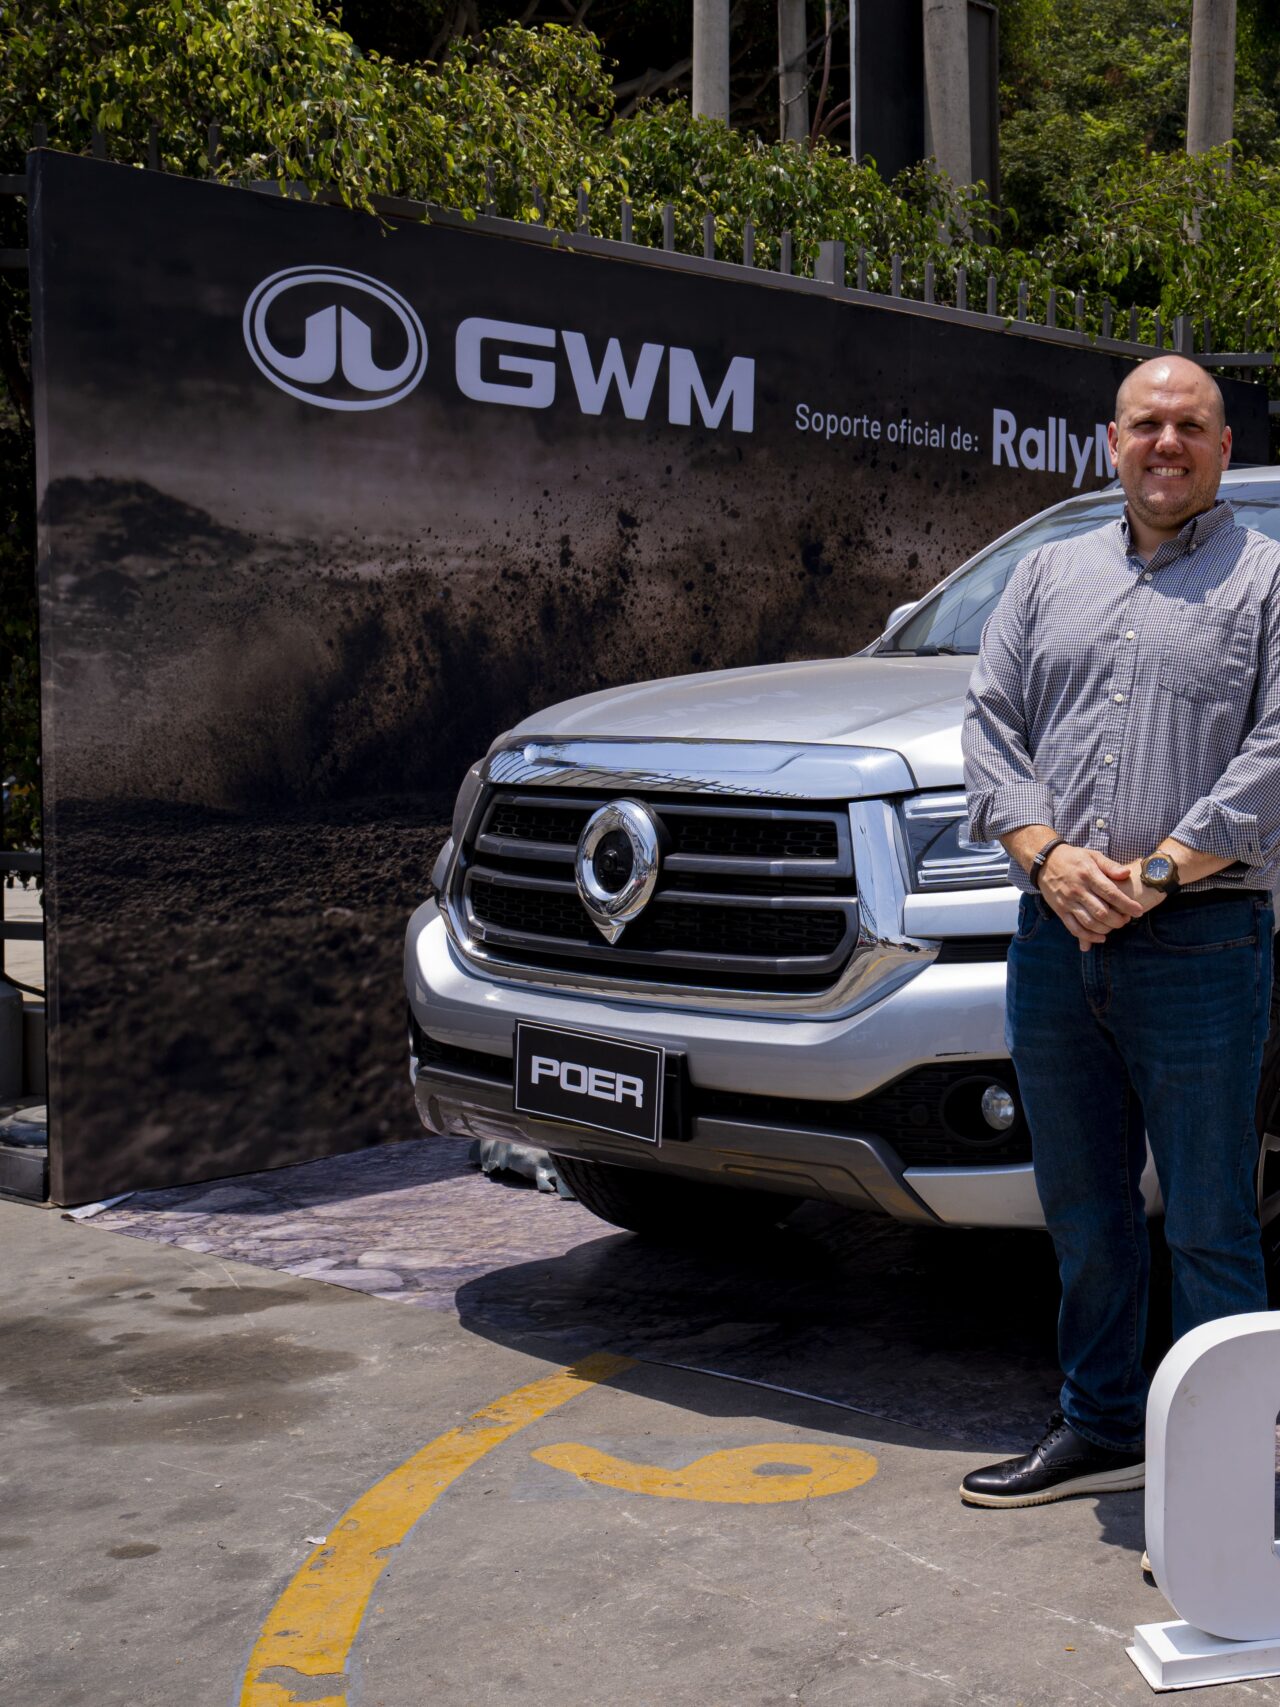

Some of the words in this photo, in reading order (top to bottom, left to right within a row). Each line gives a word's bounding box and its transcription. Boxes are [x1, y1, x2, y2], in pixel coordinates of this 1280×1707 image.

[455, 317, 755, 433] GWM
[795, 403, 881, 440] Soporte
[887, 419, 945, 449] oficial
[950, 426, 979, 452] de:
[531, 1055, 644, 1108] POER
